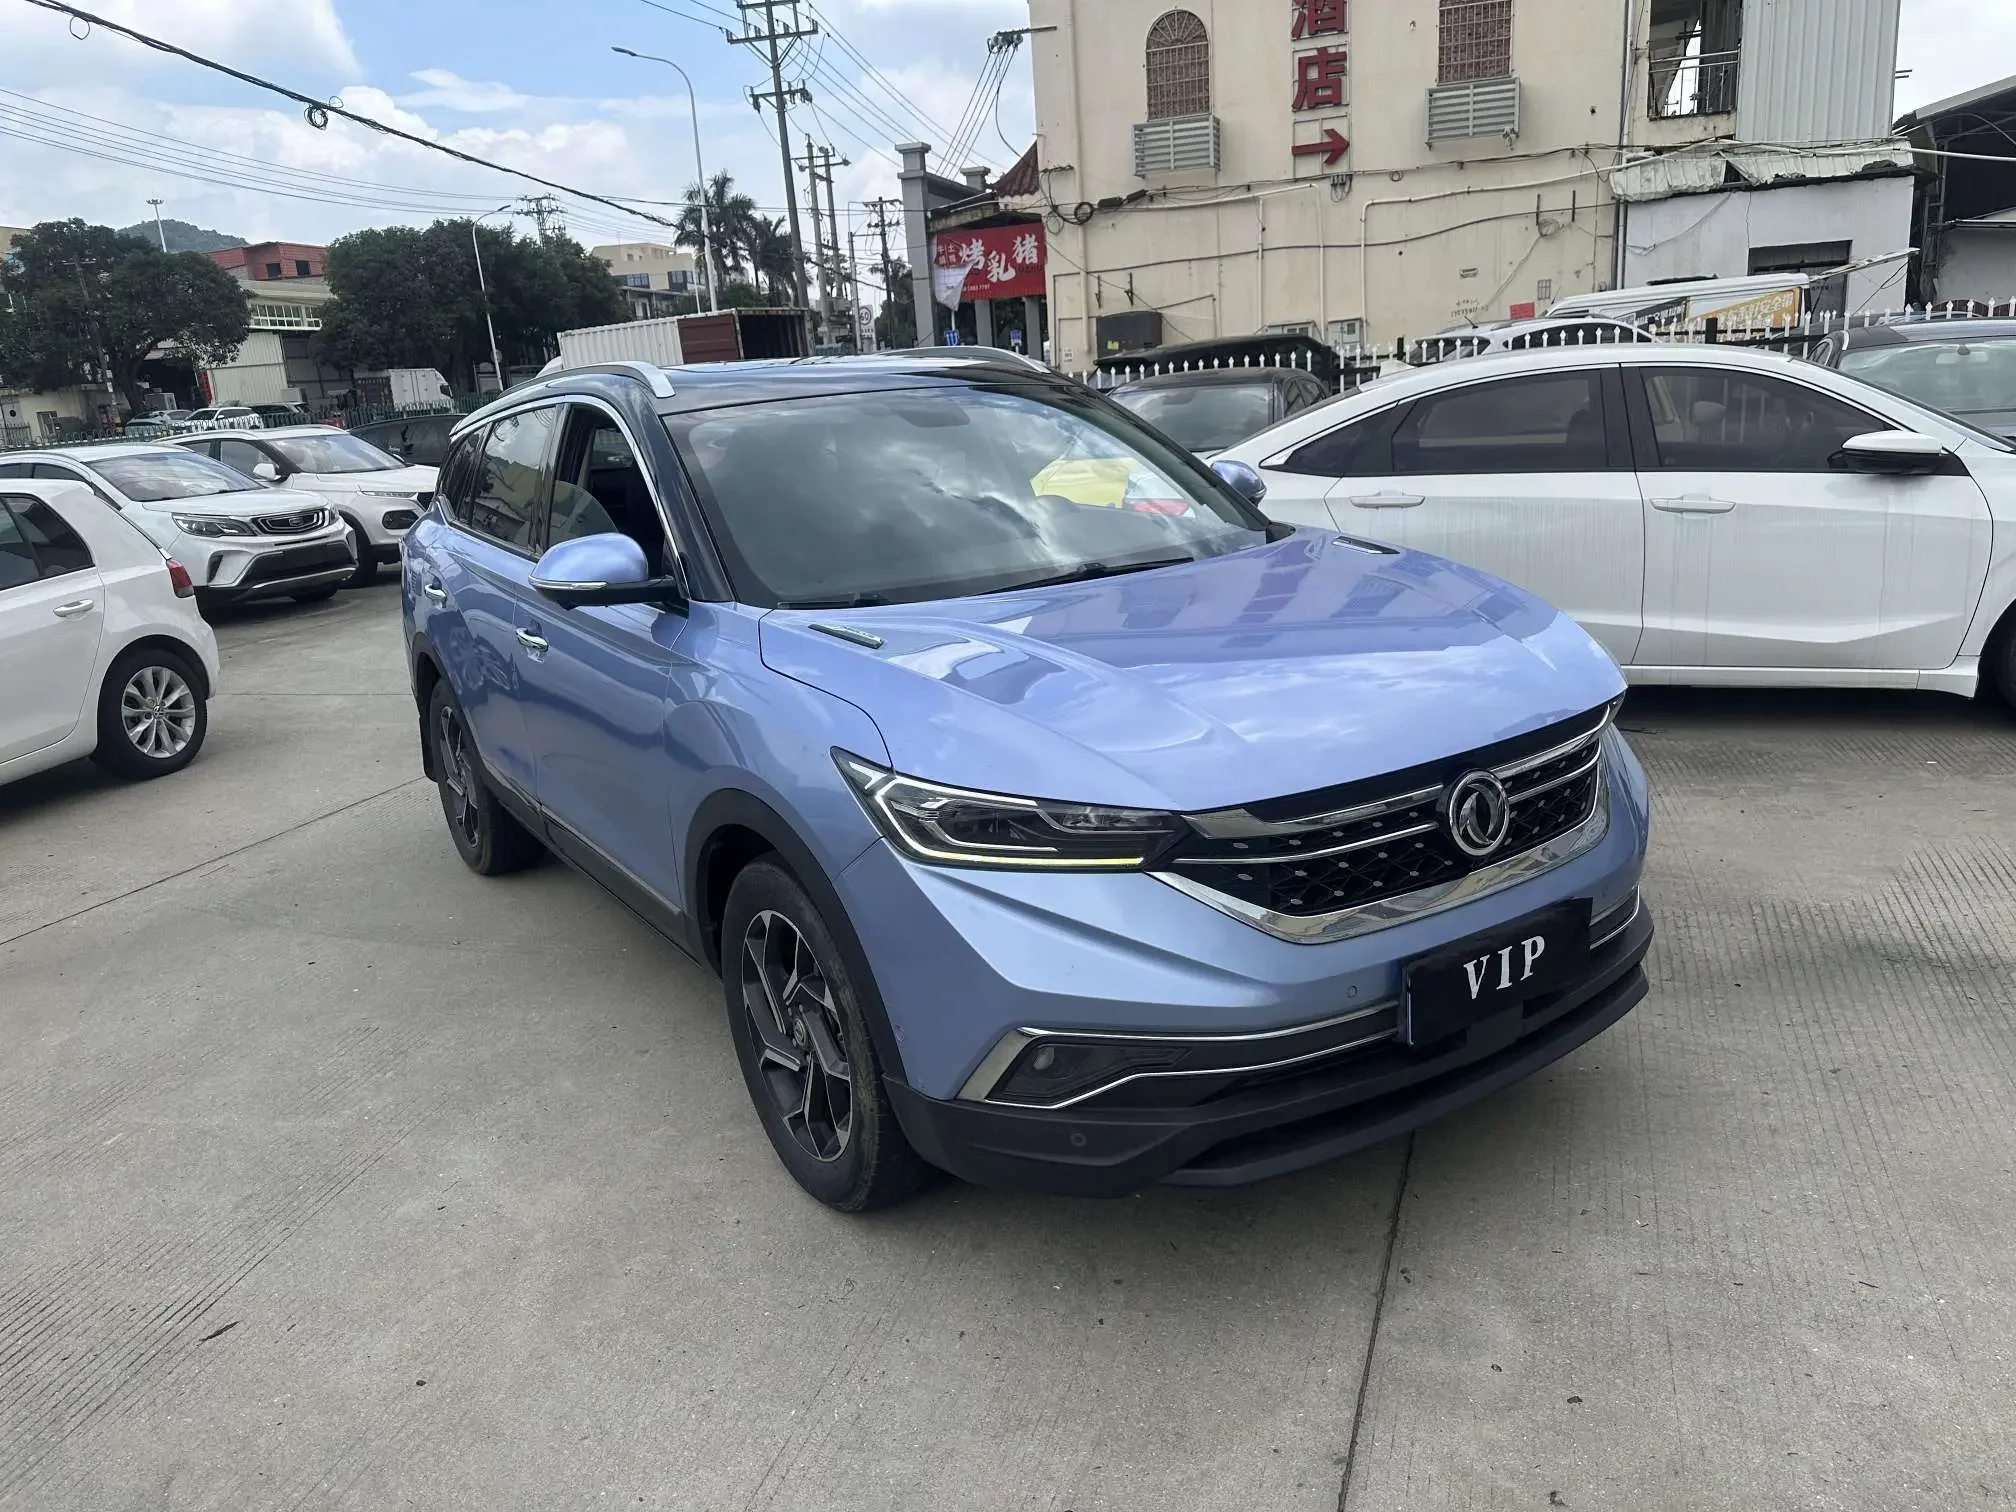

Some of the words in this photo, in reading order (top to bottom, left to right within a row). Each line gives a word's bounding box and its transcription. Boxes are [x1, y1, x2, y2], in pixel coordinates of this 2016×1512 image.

[1291, 0, 1347, 108] 酒店
[959, 234, 1038, 283] 烤乳猪
[1463, 935, 1546, 1000] VIP
